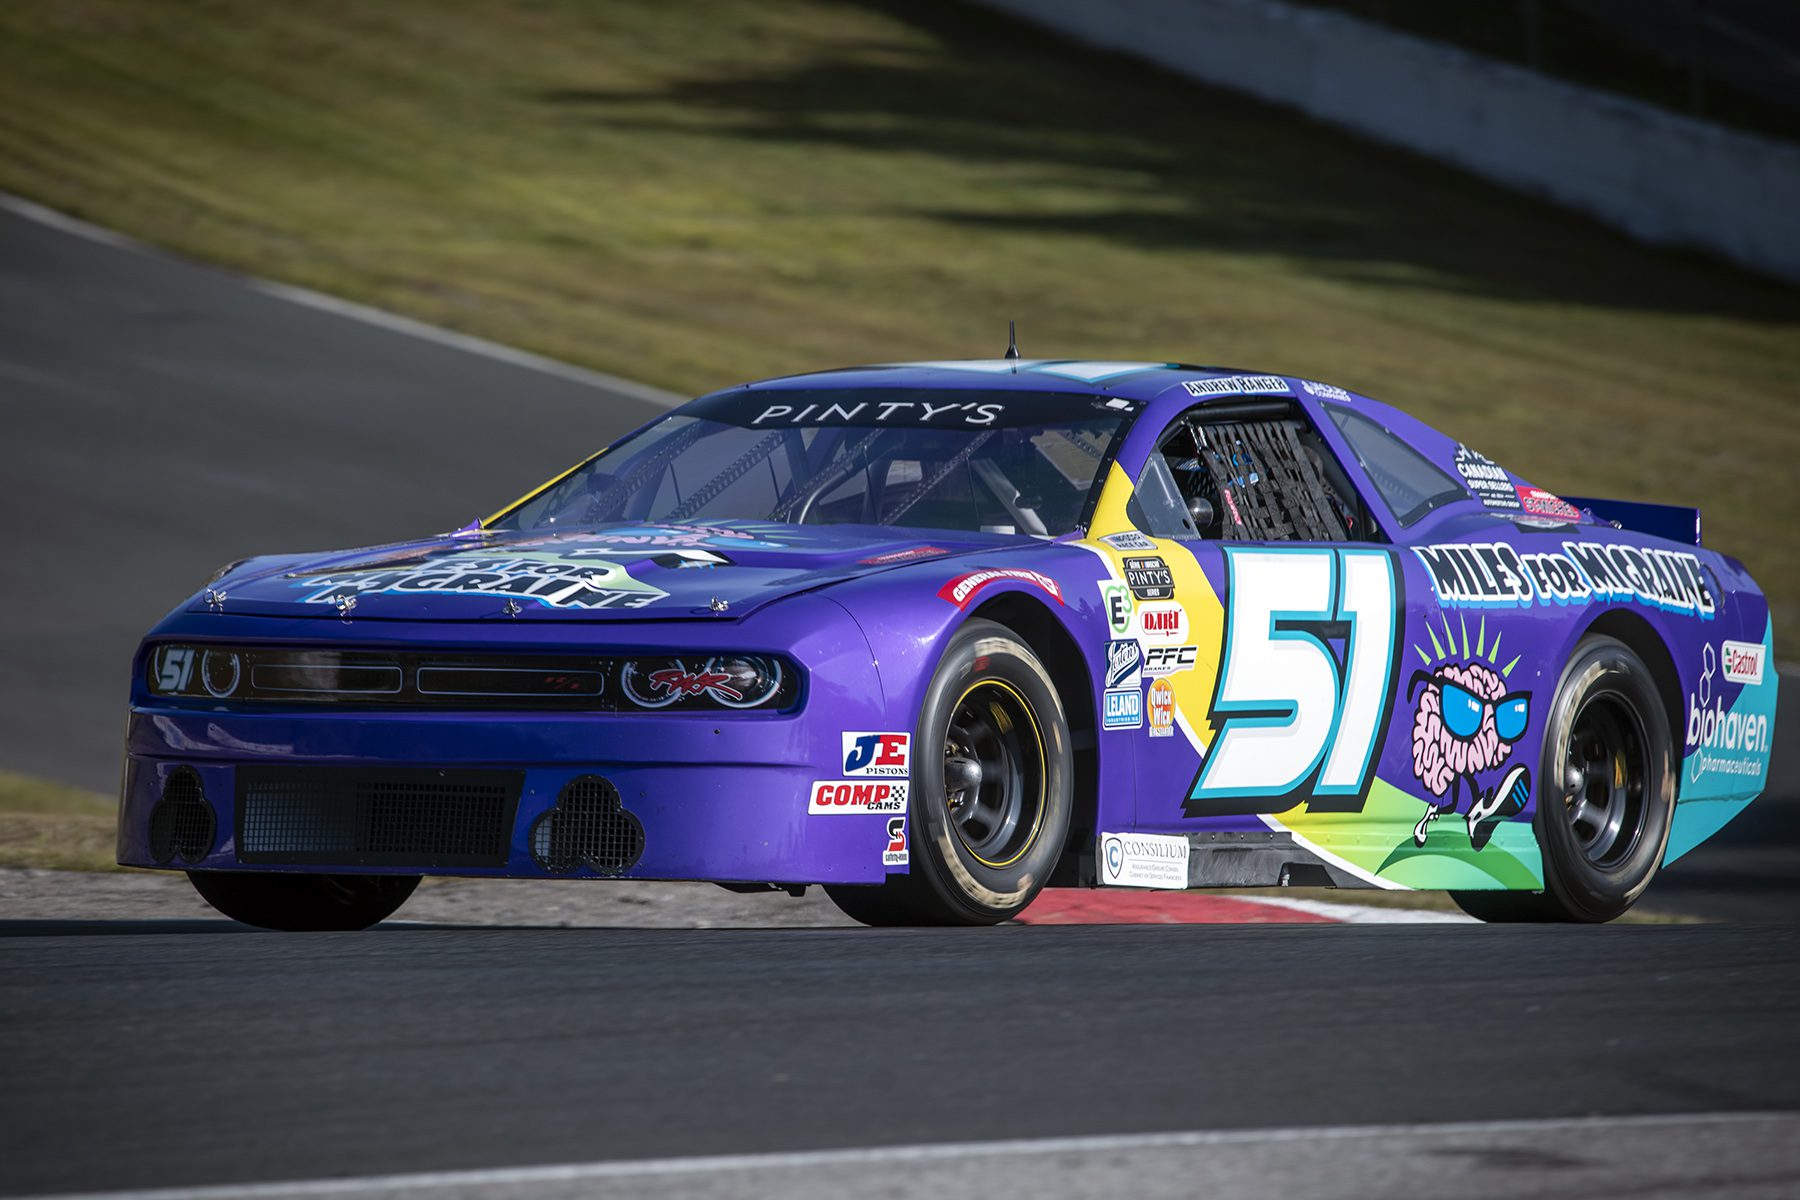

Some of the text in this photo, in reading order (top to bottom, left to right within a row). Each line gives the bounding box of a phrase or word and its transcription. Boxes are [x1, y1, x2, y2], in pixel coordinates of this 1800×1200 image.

[1183, 376, 1289, 396] ANDREW RANGER
[751, 402, 1005, 425] PINTY'S
[503, 561, 616, 582] FOR
[1128, 570, 1171, 586] PINTY'S
[1410, 542, 1716, 614] MILES FOR MIGRAINE
[302, 571, 671, 610] MIGRAINE
[952, 570, 1007, 603] GENERAL
[1146, 647, 1197, 666] PFC
[1732, 650, 1758, 676] Castrol
[159, 649, 195, 691] 51
[1189, 546, 1397, 800] 51
[1107, 695, 1138, 717] LELAND
[1151, 685, 1172, 708] Qwick
[1153, 706, 1171, 726] Wick
[1686, 693, 1767, 752] biohaven
[845, 735, 907, 772] JE
[1702, 753, 1762, 776] pharmaceuticals
[866, 767, 908, 776] PISTONS
[816, 785, 891, 806] COMP
[867, 802, 901, 811] CAMS
[1124, 841, 1187, 859] CONSILIUM
